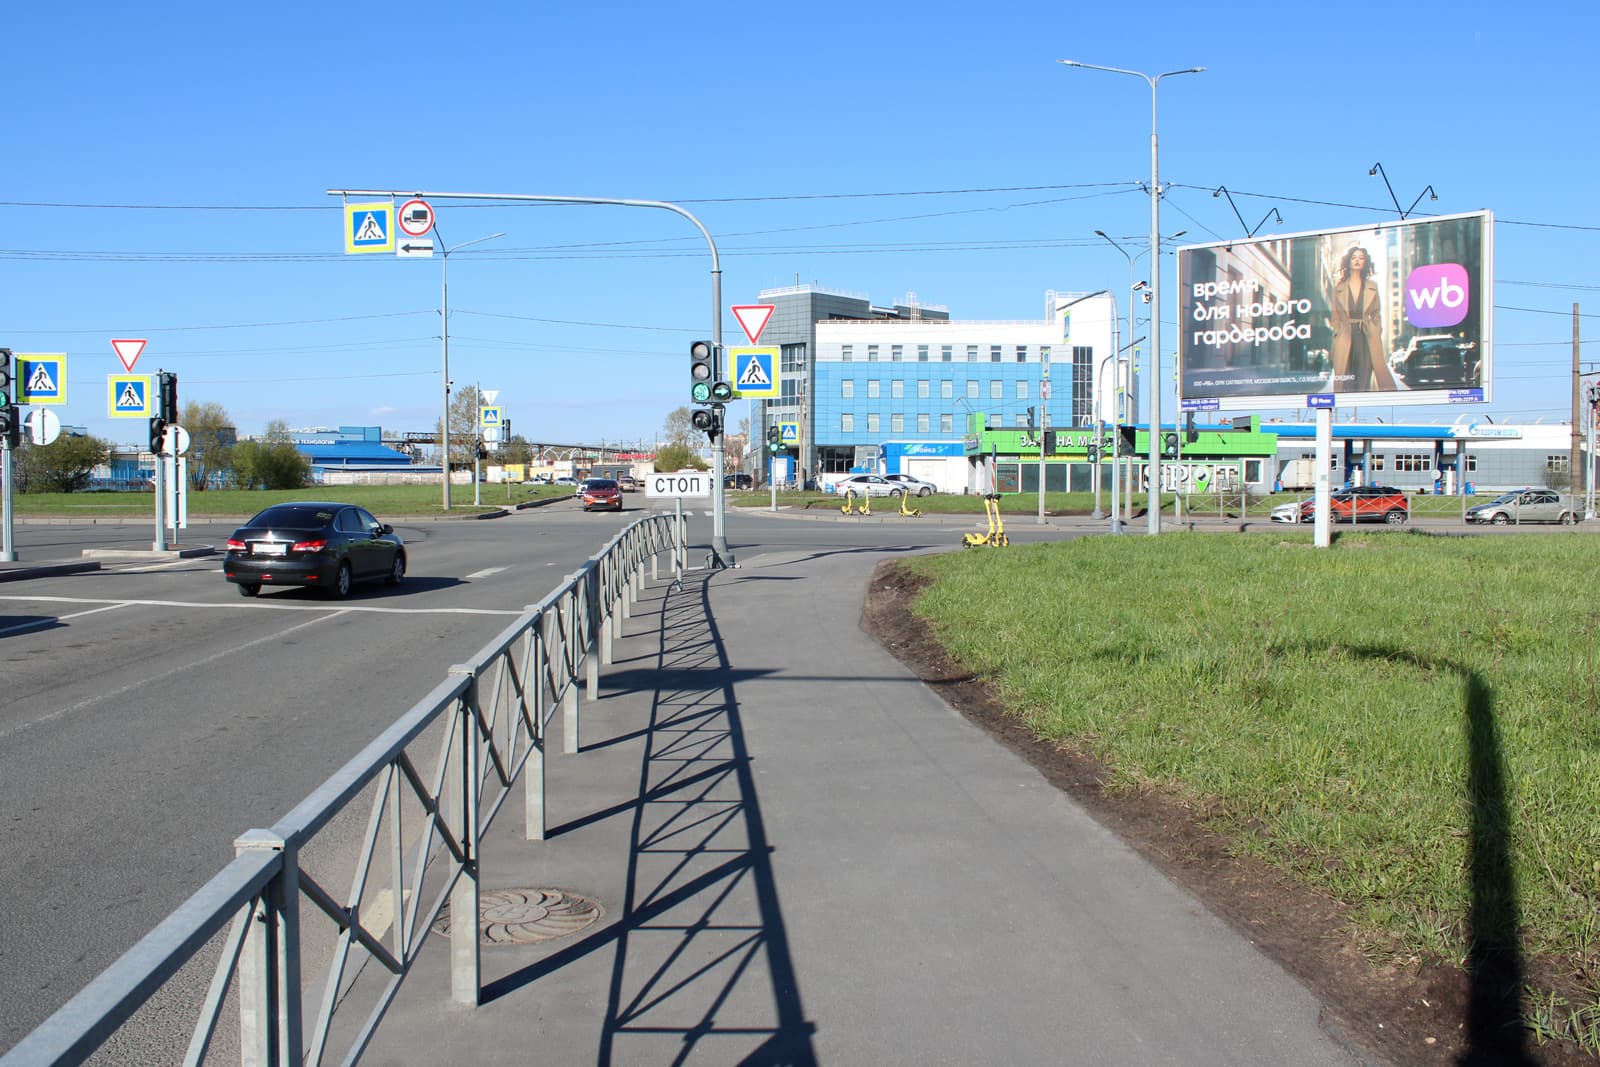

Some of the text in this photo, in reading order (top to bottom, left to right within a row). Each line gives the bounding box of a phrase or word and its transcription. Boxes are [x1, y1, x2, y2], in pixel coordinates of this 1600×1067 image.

[1193, 279, 1259, 301] время
[1409, 276, 1464, 310] wb
[1193, 298, 1312, 321] для нового
[1193, 319, 1312, 349] гардероба
[655, 477, 700, 493] СТОП
